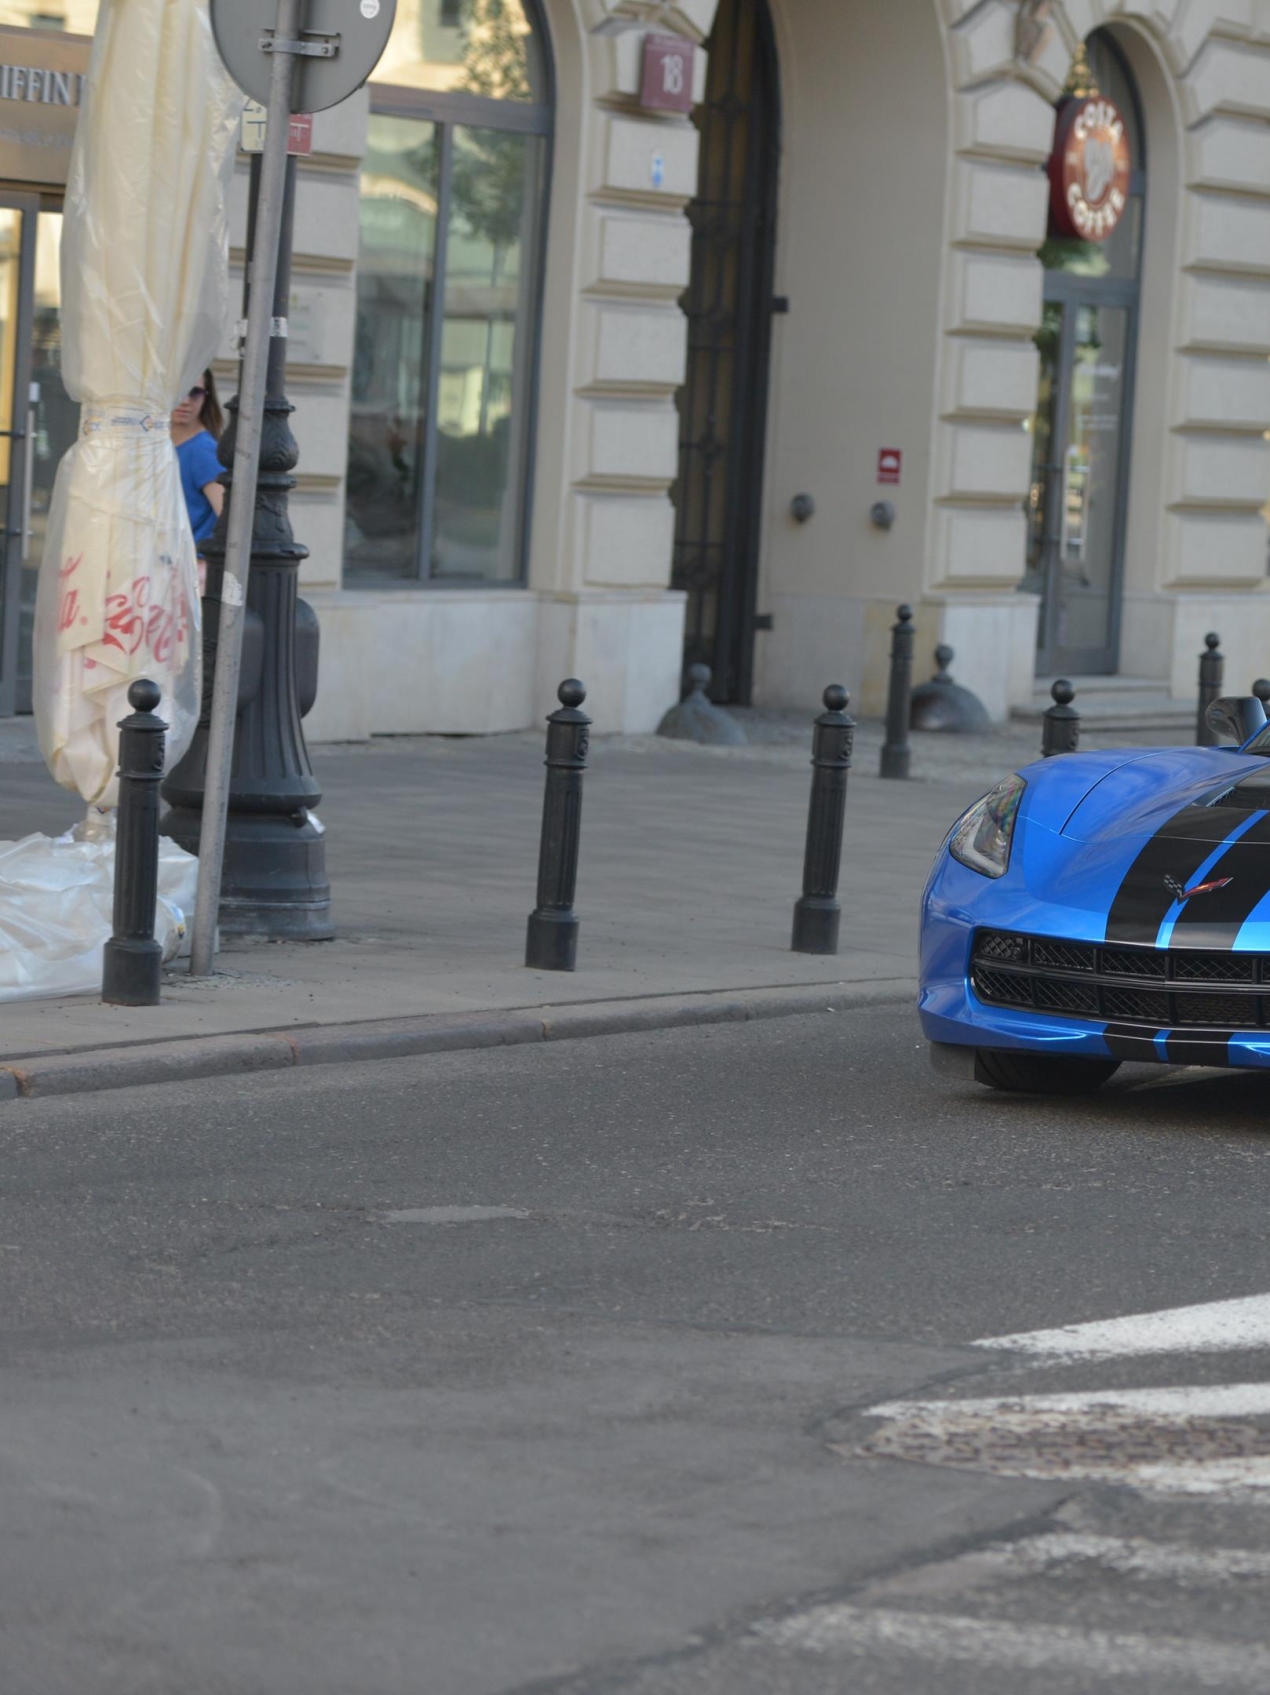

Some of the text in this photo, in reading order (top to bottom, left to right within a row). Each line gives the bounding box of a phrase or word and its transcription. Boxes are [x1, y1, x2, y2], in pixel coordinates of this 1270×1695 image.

[660, 54, 684, 95] 18
[1073, 101, 1124, 146] COSTA
[1066, 182, 1126, 236] COFFEE
